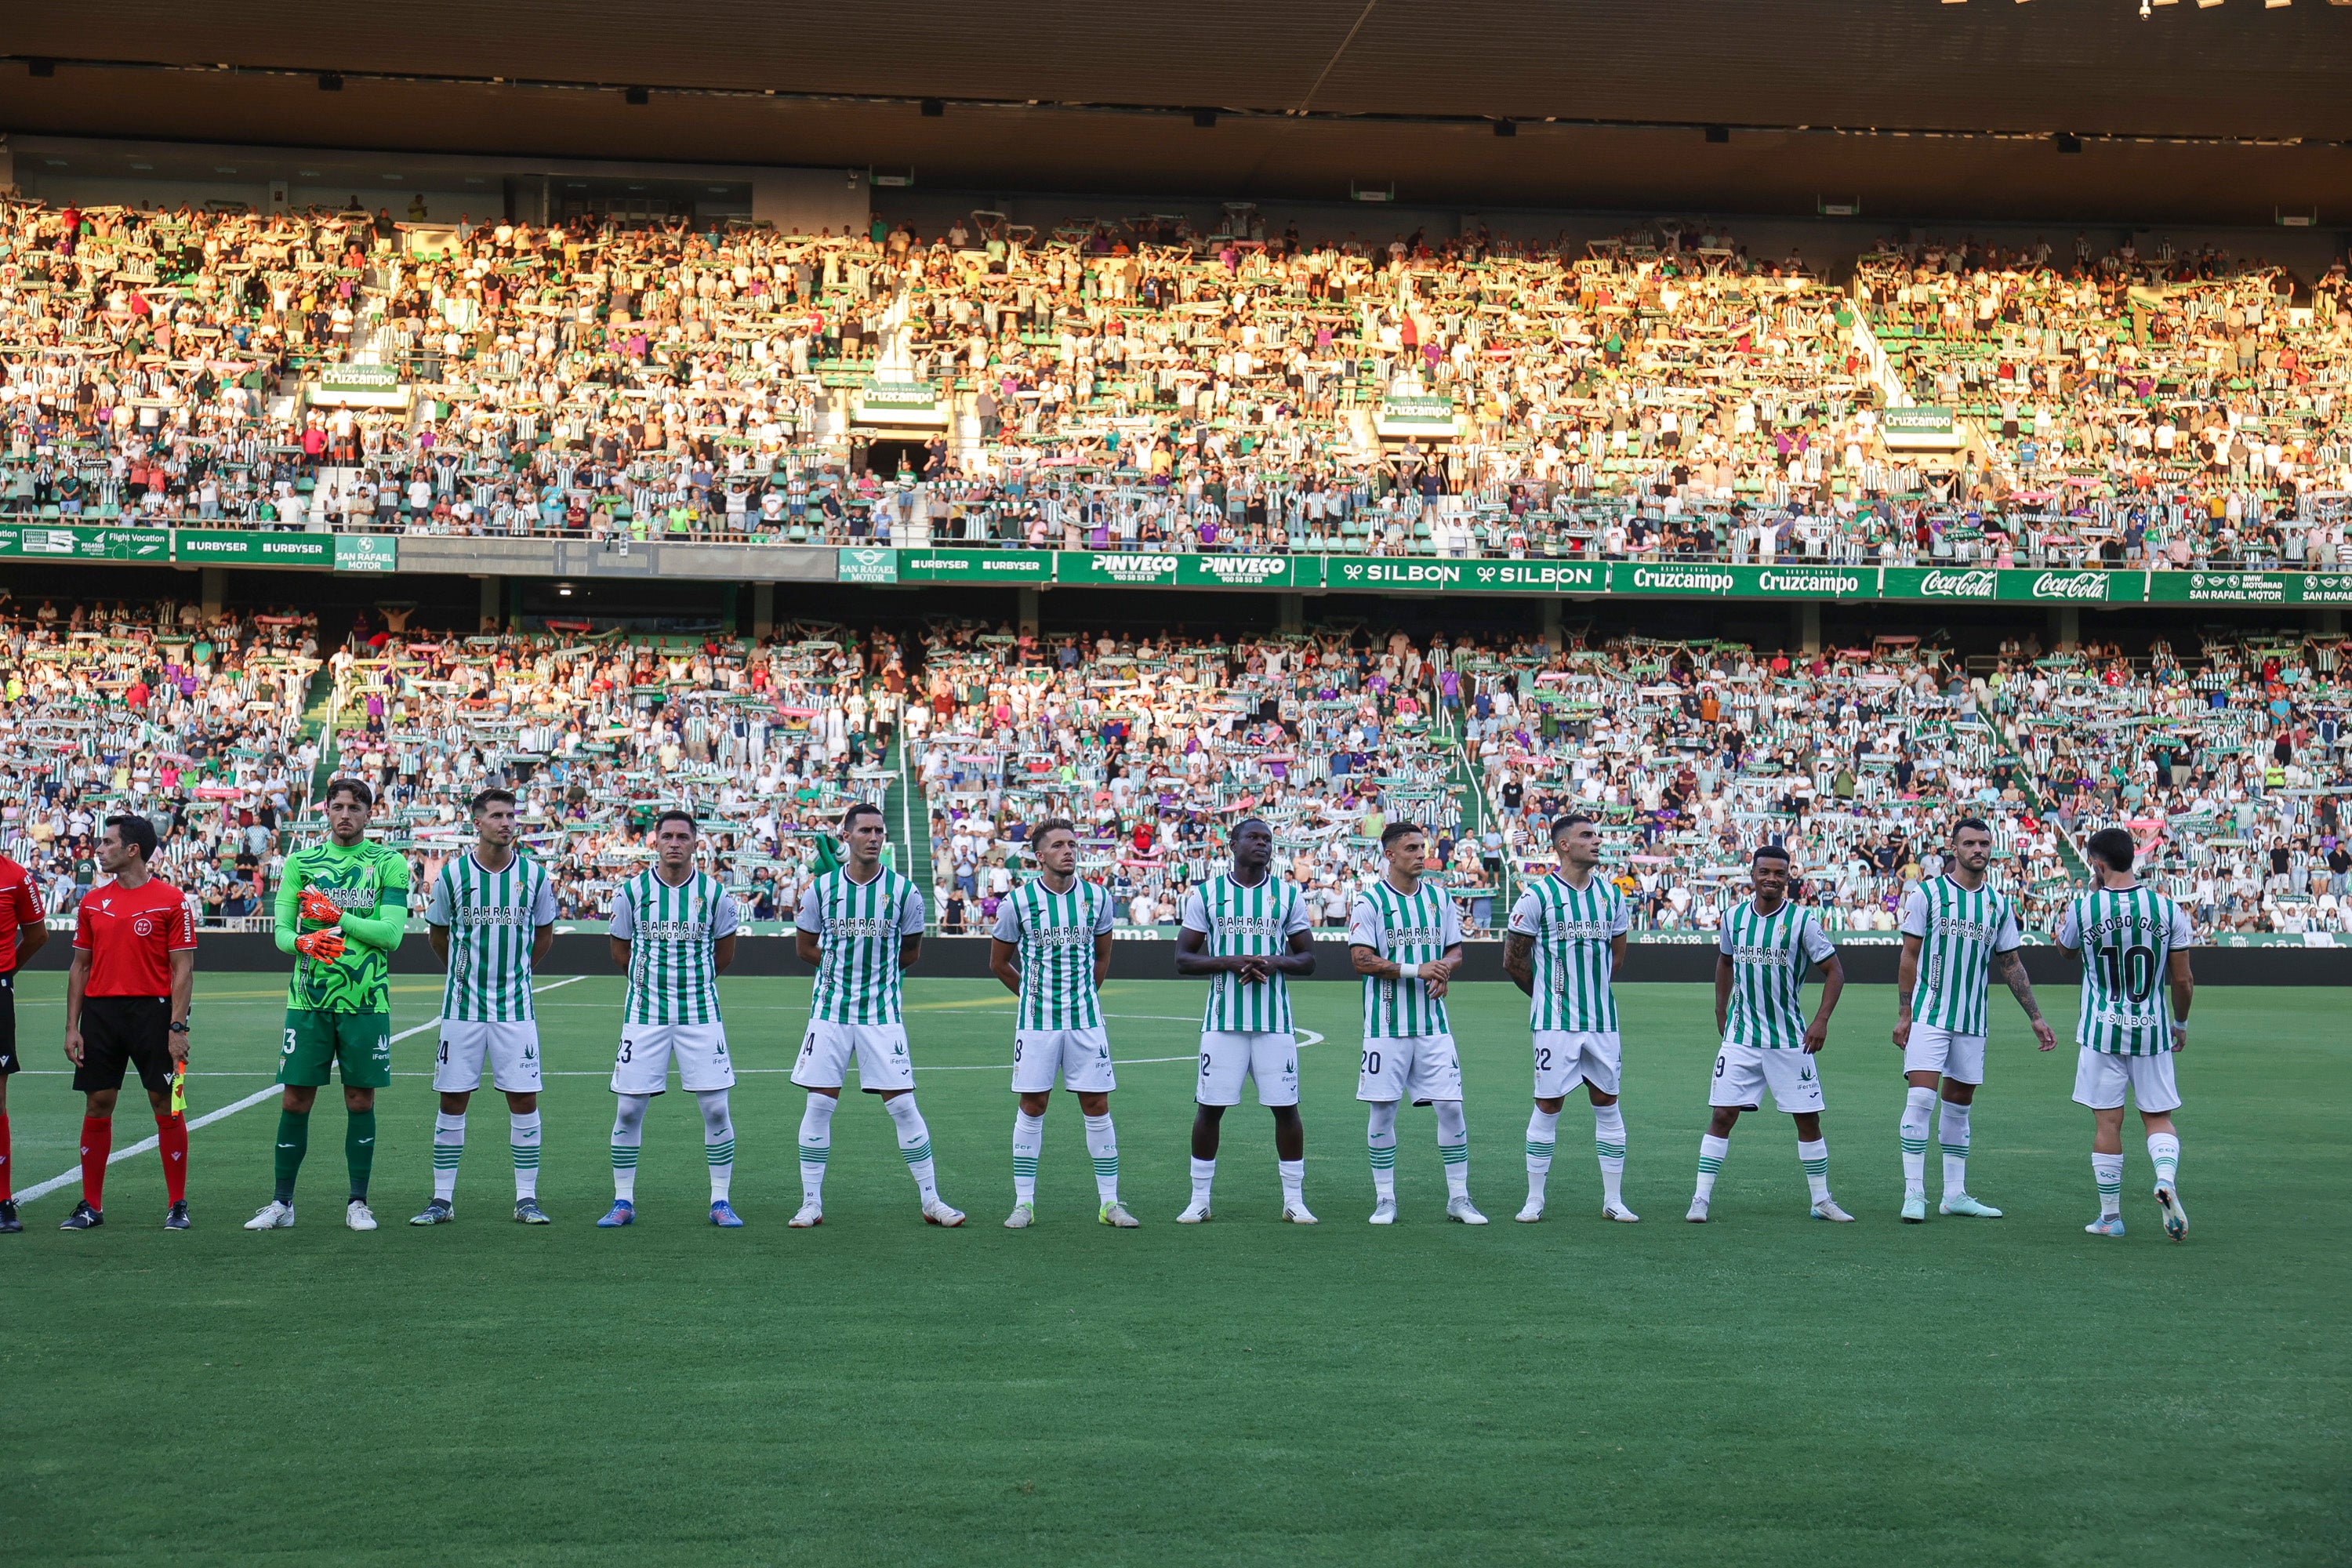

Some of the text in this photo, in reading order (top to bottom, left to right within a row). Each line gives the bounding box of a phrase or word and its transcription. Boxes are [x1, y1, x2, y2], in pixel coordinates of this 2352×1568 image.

[322, 371, 395, 387] Cruzcampo
[864, 388, 934, 405] Cruzcampo
[1385, 402, 1451, 418] Cruzcampo
[1886, 413, 1951, 428] Cruzcampo
[109, 533, 130, 543] Flight
[197, 541, 248, 552] URBYSER
[272, 543, 323, 554] URBYSER
[336, 552, 393, 562] SAN RAFAEL
[1091, 554, 1178, 572] PINVECO
[347, 561, 381, 570] MOTOR
[840, 564, 896, 574] SAN RAFAEL
[920, 560, 969, 569] URBYSER
[992, 561, 1040, 571] URBYSER
[1200, 557, 1285, 574] PINVECO
[851, 573, 884, 582] MOTOR
[1367, 564, 1460, 582] SILBON
[1500, 567, 1592, 583] SILBON
[1634, 567, 1733, 592] Cruzcampo
[1759, 570, 1858, 594] Cruzcampo
[1921, 570, 1998, 597] Coca-Cola
[2032, 572, 2109, 598] Coca-Cola
[2190, 590, 2281, 600] SAN RAFAEL MOTOR
[2303, 592, 2321, 601] SAN
[322, 887, 376, 899] AHRAIN
[332, 898, 374, 909] TORIOUS
[463, 906, 527, 917] BAHRAIN
[463, 916, 524, 926] VICTORIOUS
[641, 920, 706, 932] BAHRAIN
[829, 918, 892, 929] BAHRAIN
[1217, 916, 1279, 929] BAHRAIN
[1556, 921, 1613, 932] BAHRAIN
[1033, 927, 1093, 940] BAHRAIN
[1219, 927, 1276, 938] VICTORIOUS
[1386, 926, 1442, 939] BAHRAIN
[1940, 918, 1996, 938] BAHRAIN
[2083, 915, 2171, 946] JACOBO GLEZ.
[1036, 938, 1091, 947] VICTORIOUS
[1388, 937, 1442, 947] VICTORIOUS
[1733, 946, 1788, 958] BAHRAIN
[2097, 945, 2155, 1004] 10
[2108, 1013, 2157, 1026] SILBON
[1361, 1050, 1381, 1075] 20
[1534, 1047, 1552, 1071] 22
